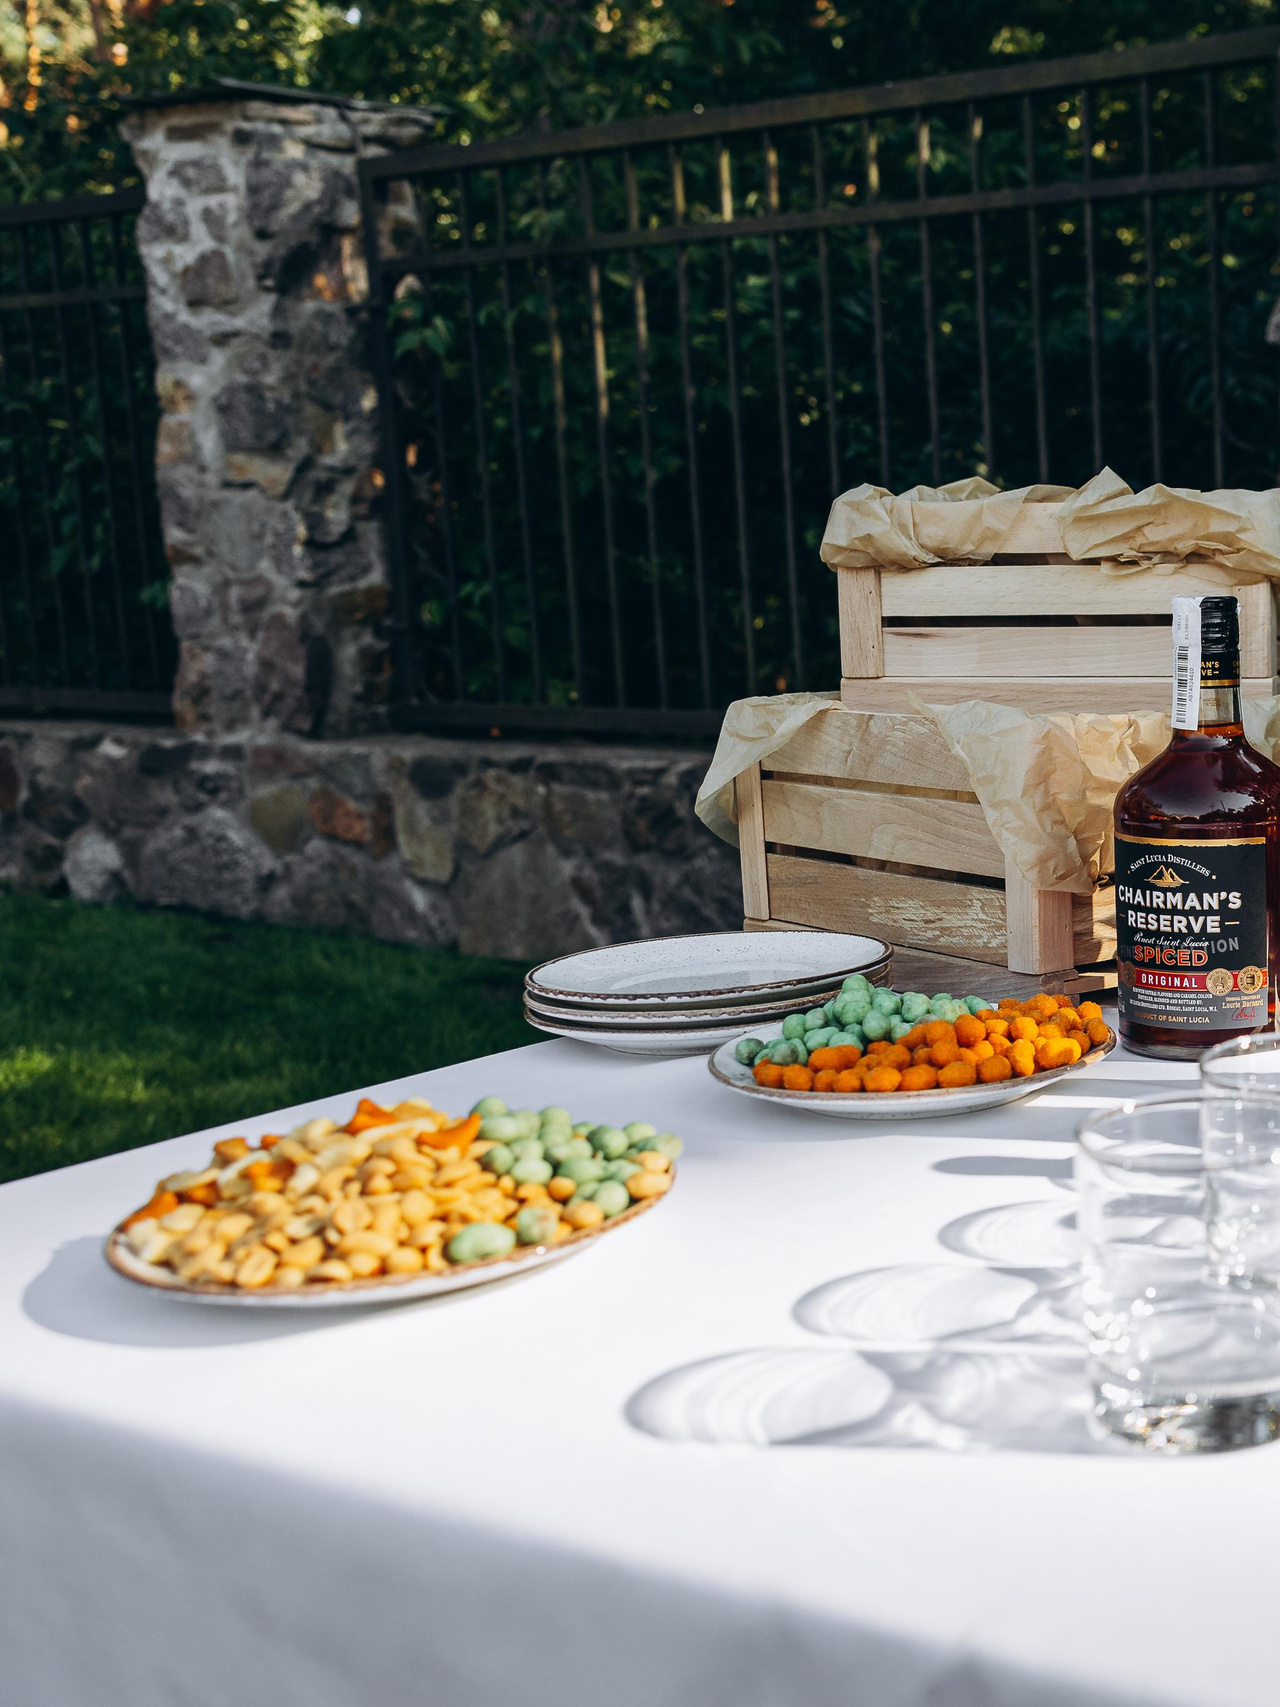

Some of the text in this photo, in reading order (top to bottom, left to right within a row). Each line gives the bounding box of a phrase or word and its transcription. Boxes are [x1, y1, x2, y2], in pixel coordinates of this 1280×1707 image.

[1130, 853, 1211, 877] SAINT LUCIA DISTILLERS
[1118, 884, 1242, 910] CHAIRMAN'S
[1127, 910, 1221, 934] RESERVE
[1133, 931, 1210, 947] Finest Saint Lucia
[1134, 944, 1209, 966] SPICED
[1141, 973, 1198, 988] ORIGINAL
[1168, 1015, 1187, 1023] SAINT
